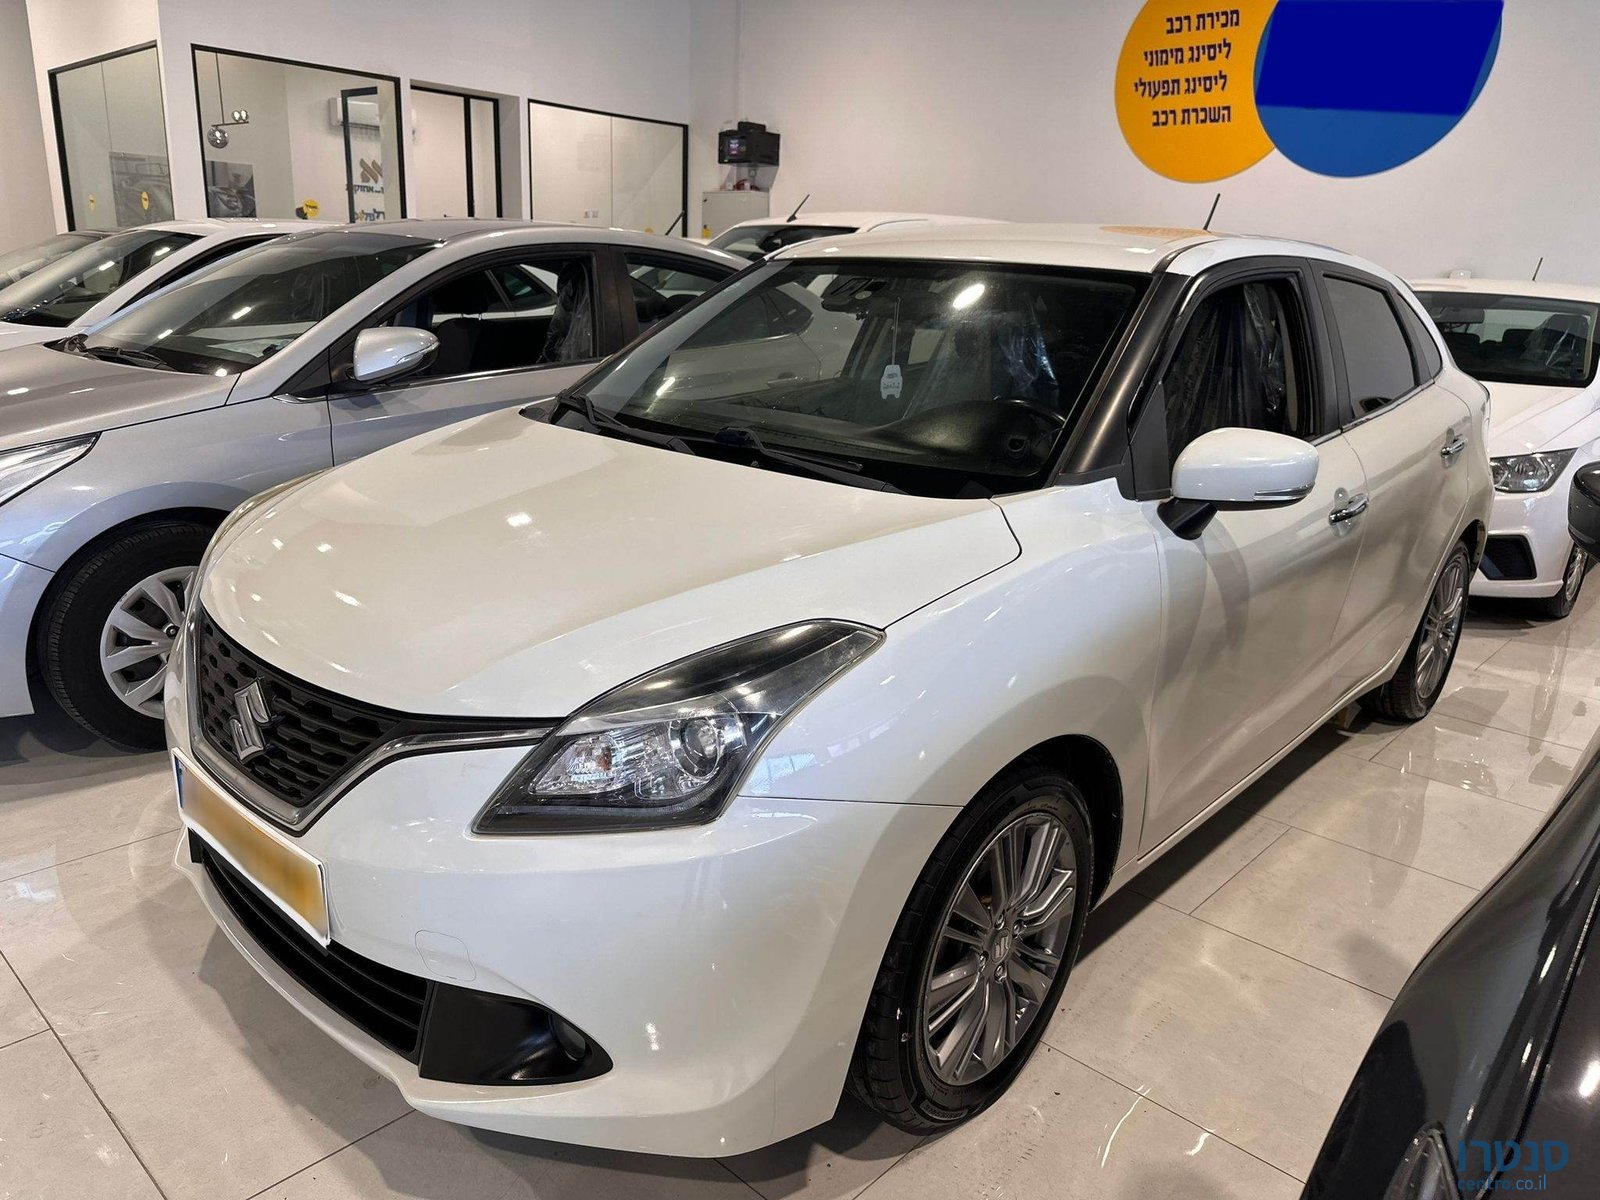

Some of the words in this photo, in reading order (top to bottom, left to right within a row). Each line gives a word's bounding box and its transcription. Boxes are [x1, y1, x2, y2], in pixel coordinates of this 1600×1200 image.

[1166, 15, 1191, 34] רכב
[1196, 9, 1240, 31] מכירת
[1144, 47, 1184, 67] מימוני
[1188, 38, 1231, 63] ליסינג
[1134, 77, 1180, 100] תפעולי
[1184, 70, 1227, 95] ליסינג
[1152, 109, 1177, 127] רכב
[1181, 105, 1231, 125] השכרת
